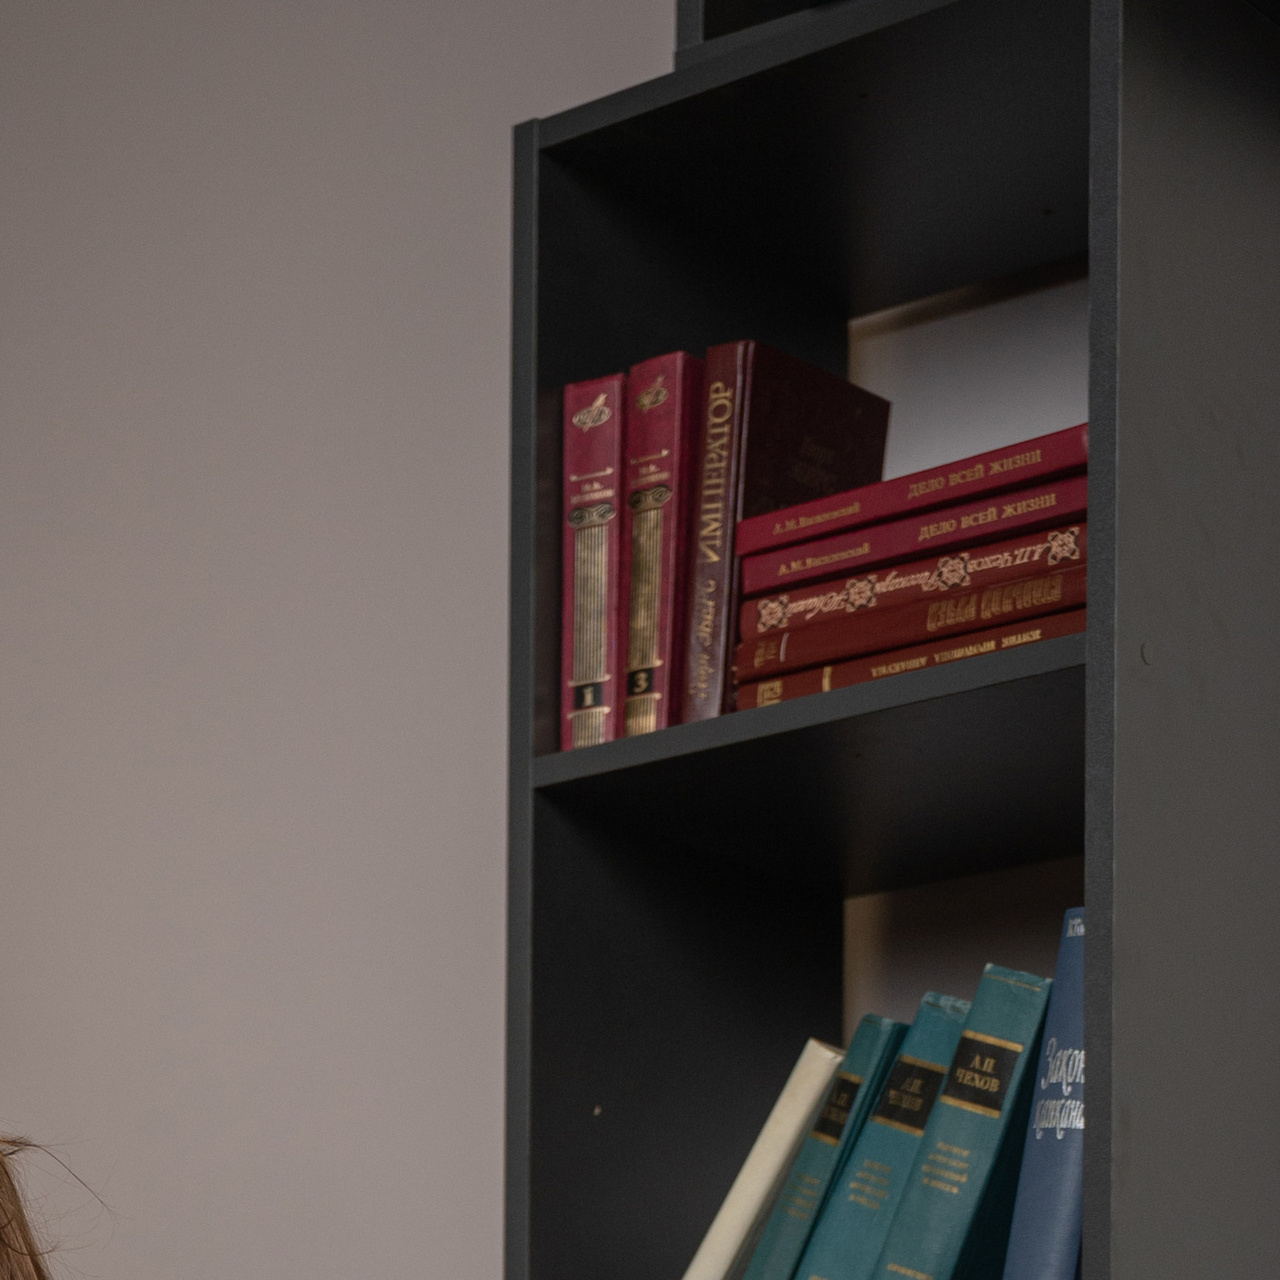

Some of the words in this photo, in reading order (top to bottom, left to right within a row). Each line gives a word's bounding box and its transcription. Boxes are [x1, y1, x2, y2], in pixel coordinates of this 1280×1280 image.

[696, 381, 733, 562] ИМПЕРАТОР
[908, 477, 945, 499] ДЕЛО
[949, 464, 984, 486] ВСЕЙ
[989, 450, 1042, 474] ЖИЗНИ
[919, 519, 957, 542] ДЕЛО
[961, 507, 998, 529] ВСЕЙ
[1002, 493, 1057, 519] ЖИЗНИ
[583, 686, 595, 707] 1
[634, 672, 649, 692] 3
[956, 1068, 1000, 1093] ЧЕХОВ
